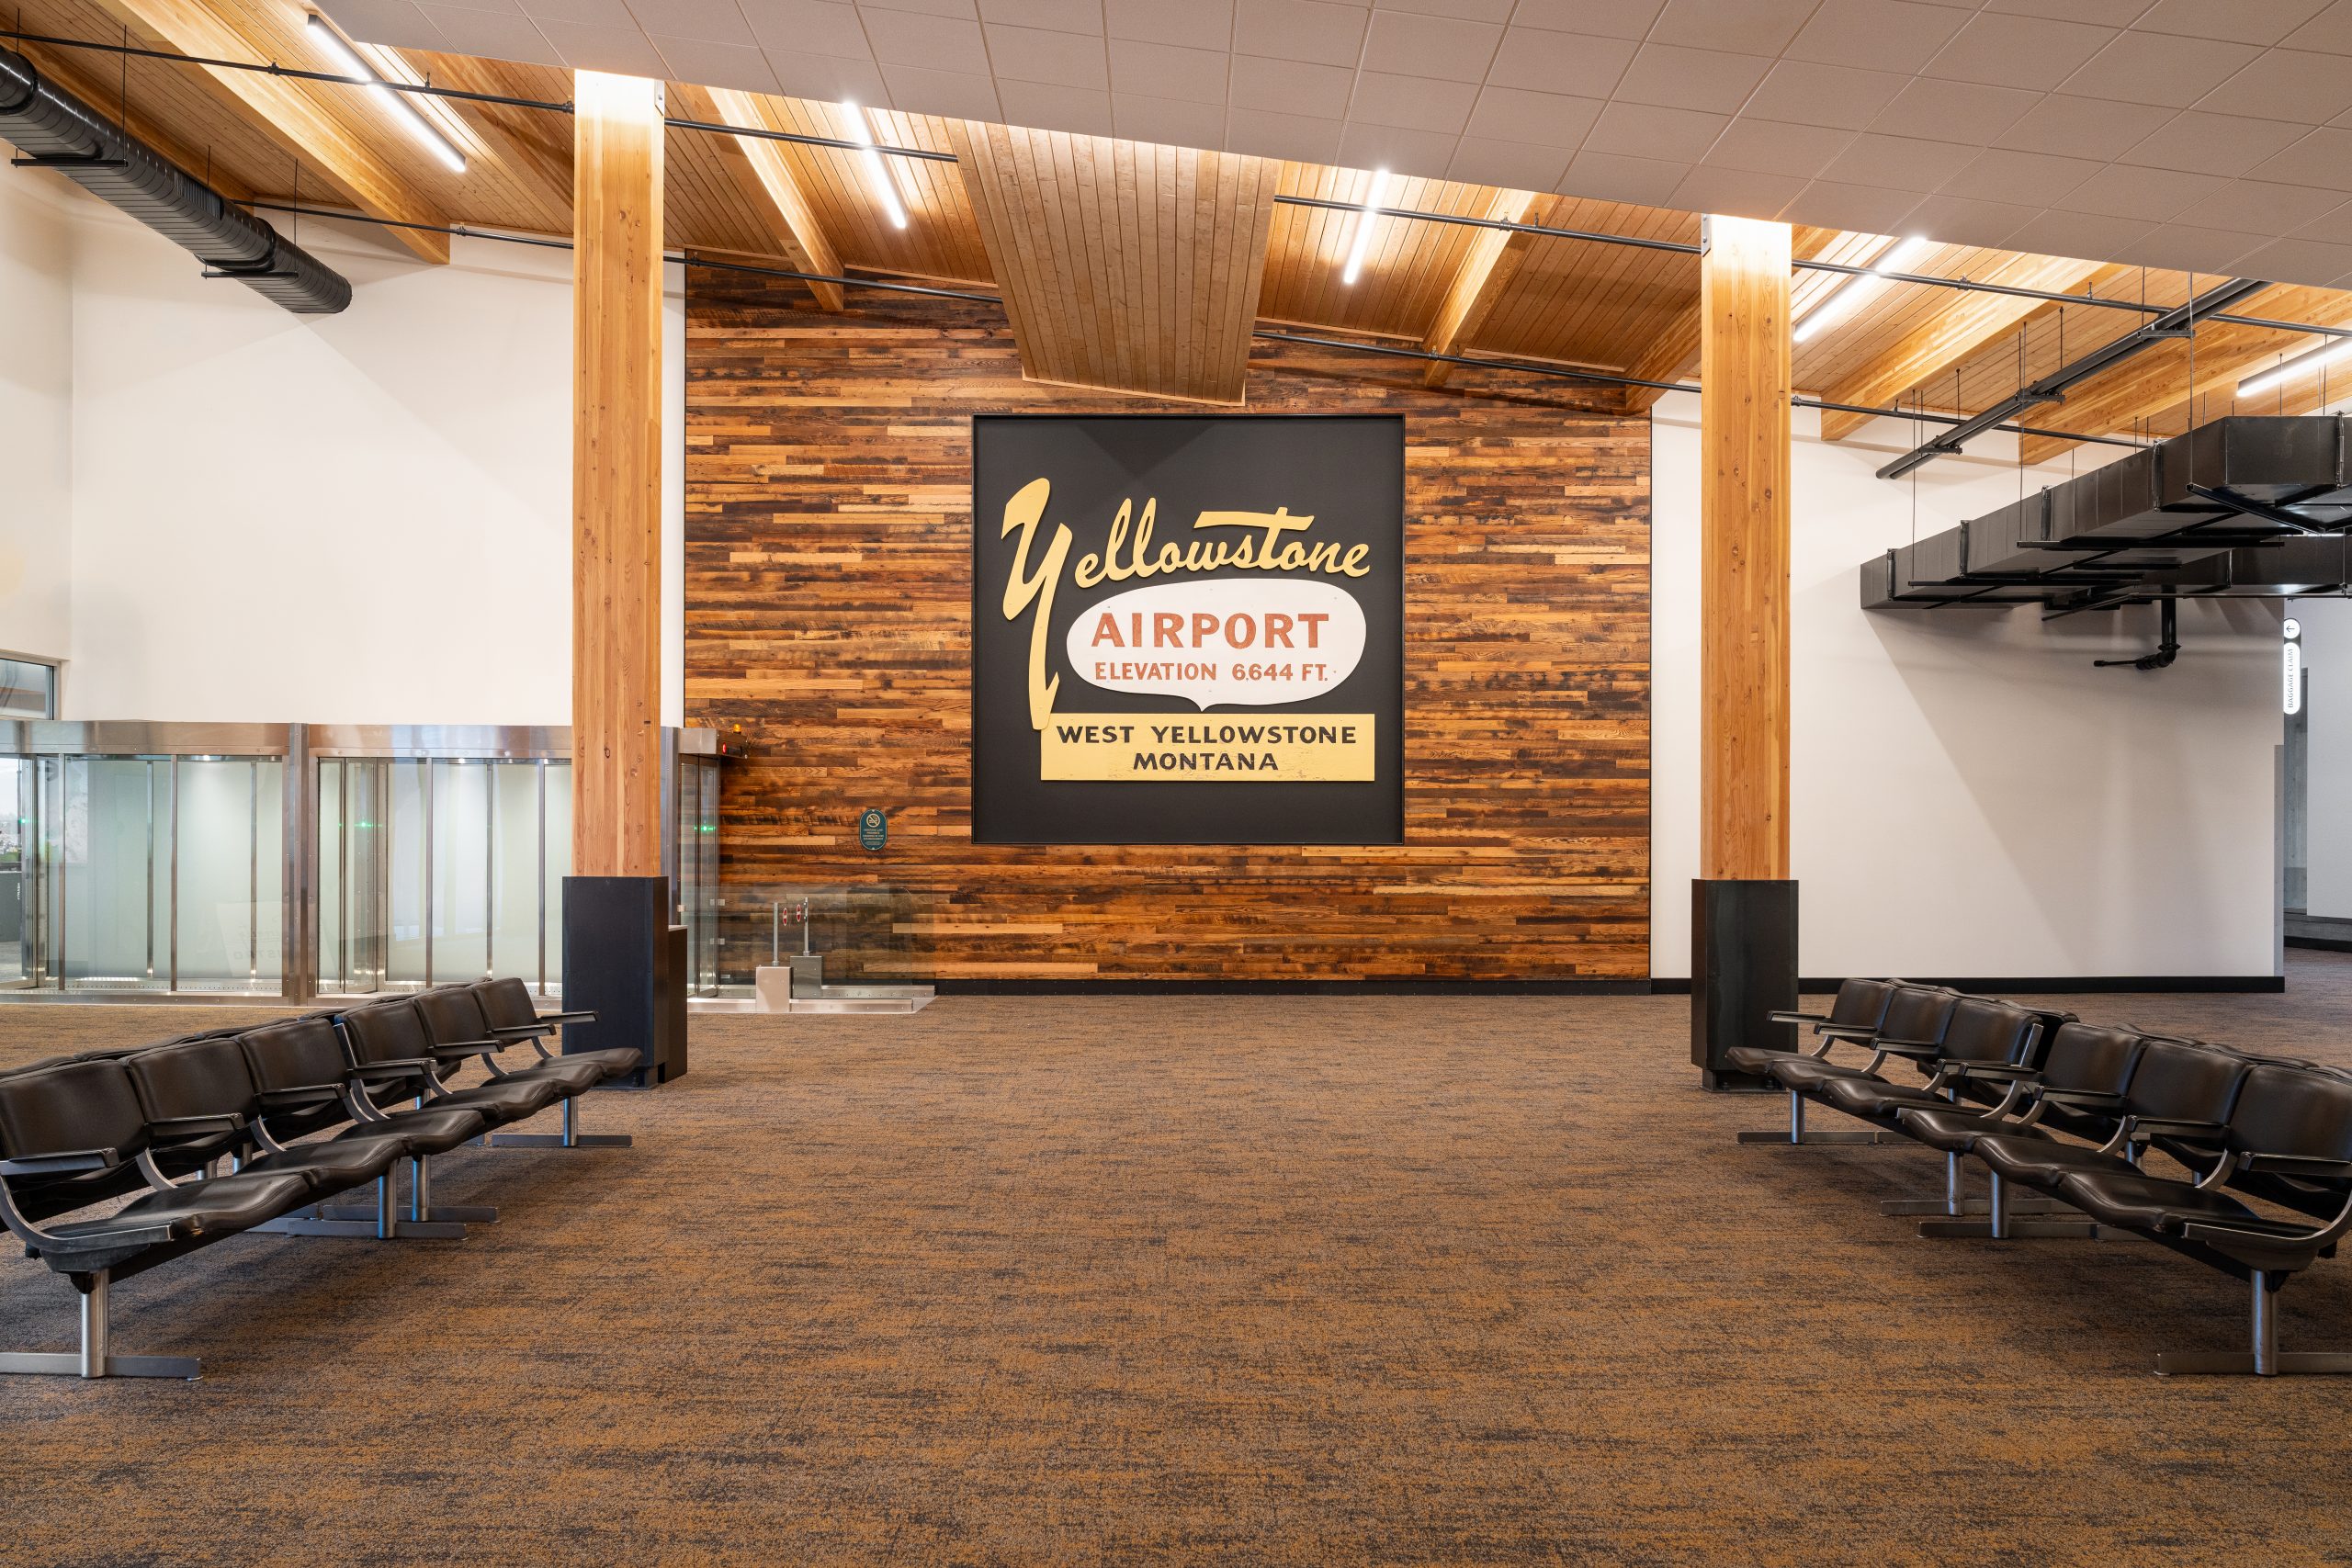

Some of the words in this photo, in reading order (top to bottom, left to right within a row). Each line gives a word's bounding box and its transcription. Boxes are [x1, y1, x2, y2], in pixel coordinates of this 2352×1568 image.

[1001, 478, 1371, 730] Yellowstone
[1091, 613, 1329, 649] AIRPORT
[1094, 661, 1217, 682] ELEVATION
[1057, 725, 1136, 744] WEST
[1150, 725, 1357, 744] YELLOWSTONE
[1133, 751, 1279, 772] MONTANA
